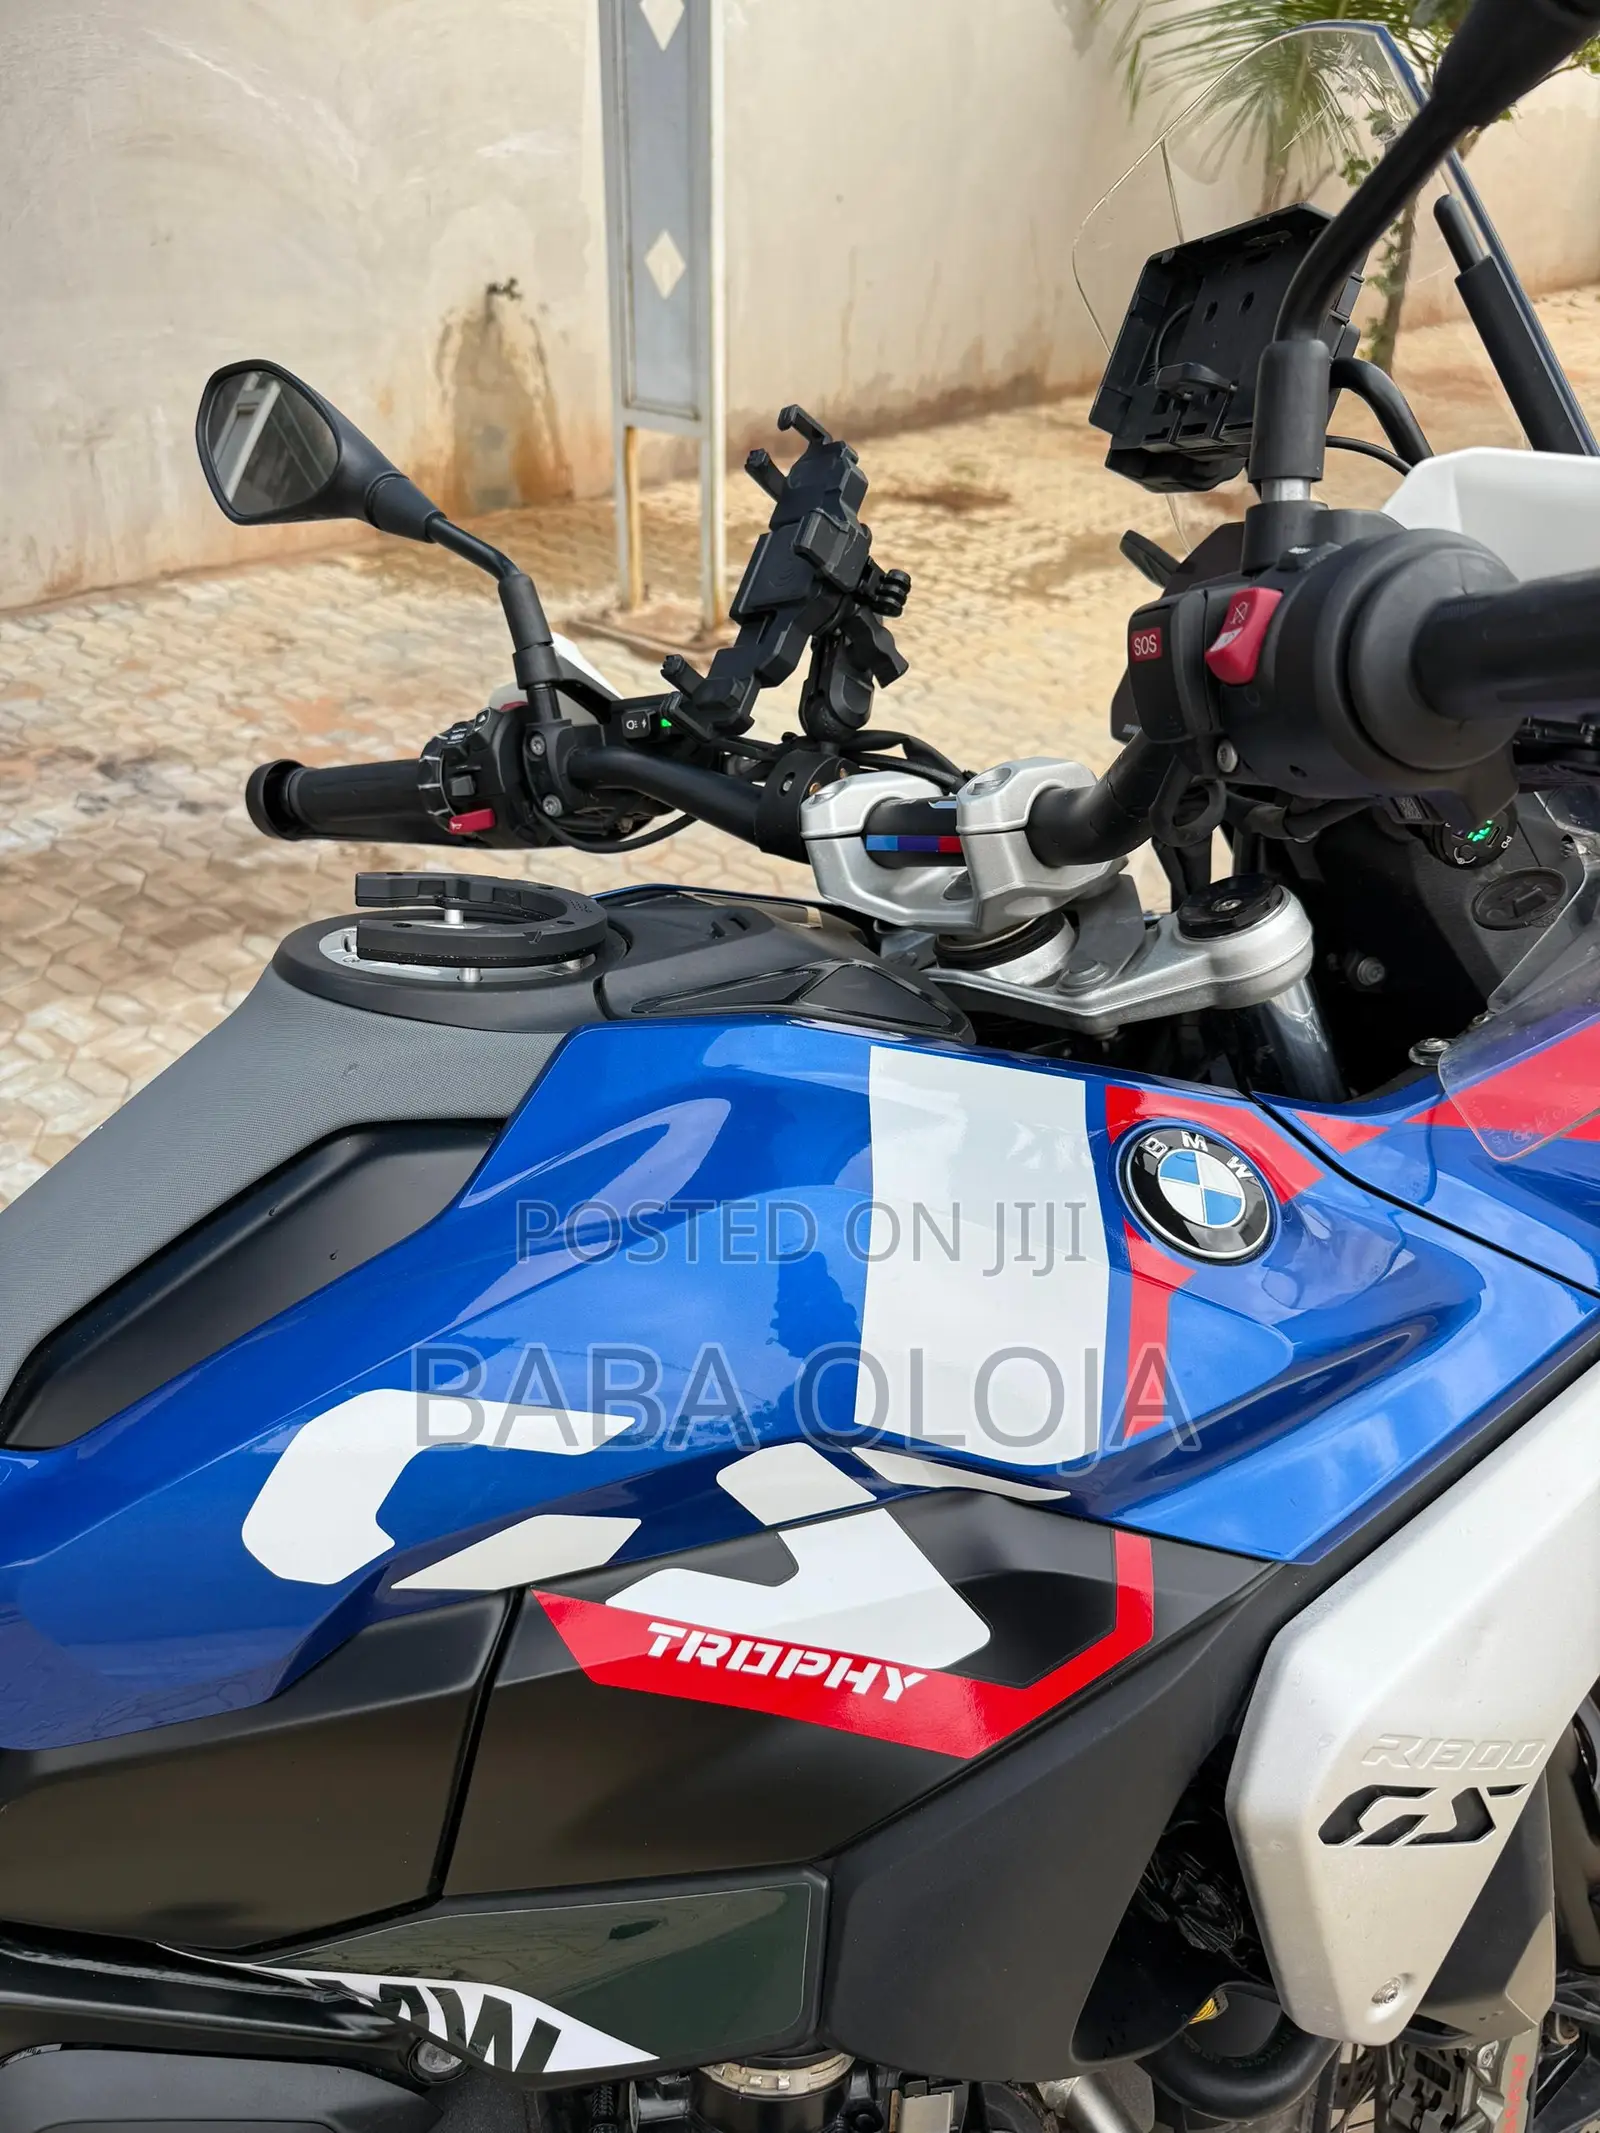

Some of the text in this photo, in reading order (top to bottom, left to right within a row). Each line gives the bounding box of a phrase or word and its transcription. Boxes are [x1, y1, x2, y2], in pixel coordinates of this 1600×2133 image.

[1133, 634, 1157, 657] SOS
[1139, 1130, 1258, 1180] BMW
[647, 1621, 928, 1703] TROPHY
[1361, 1733, 1547, 1770] R1300
[1317, 1783, 1530, 1847] GS
